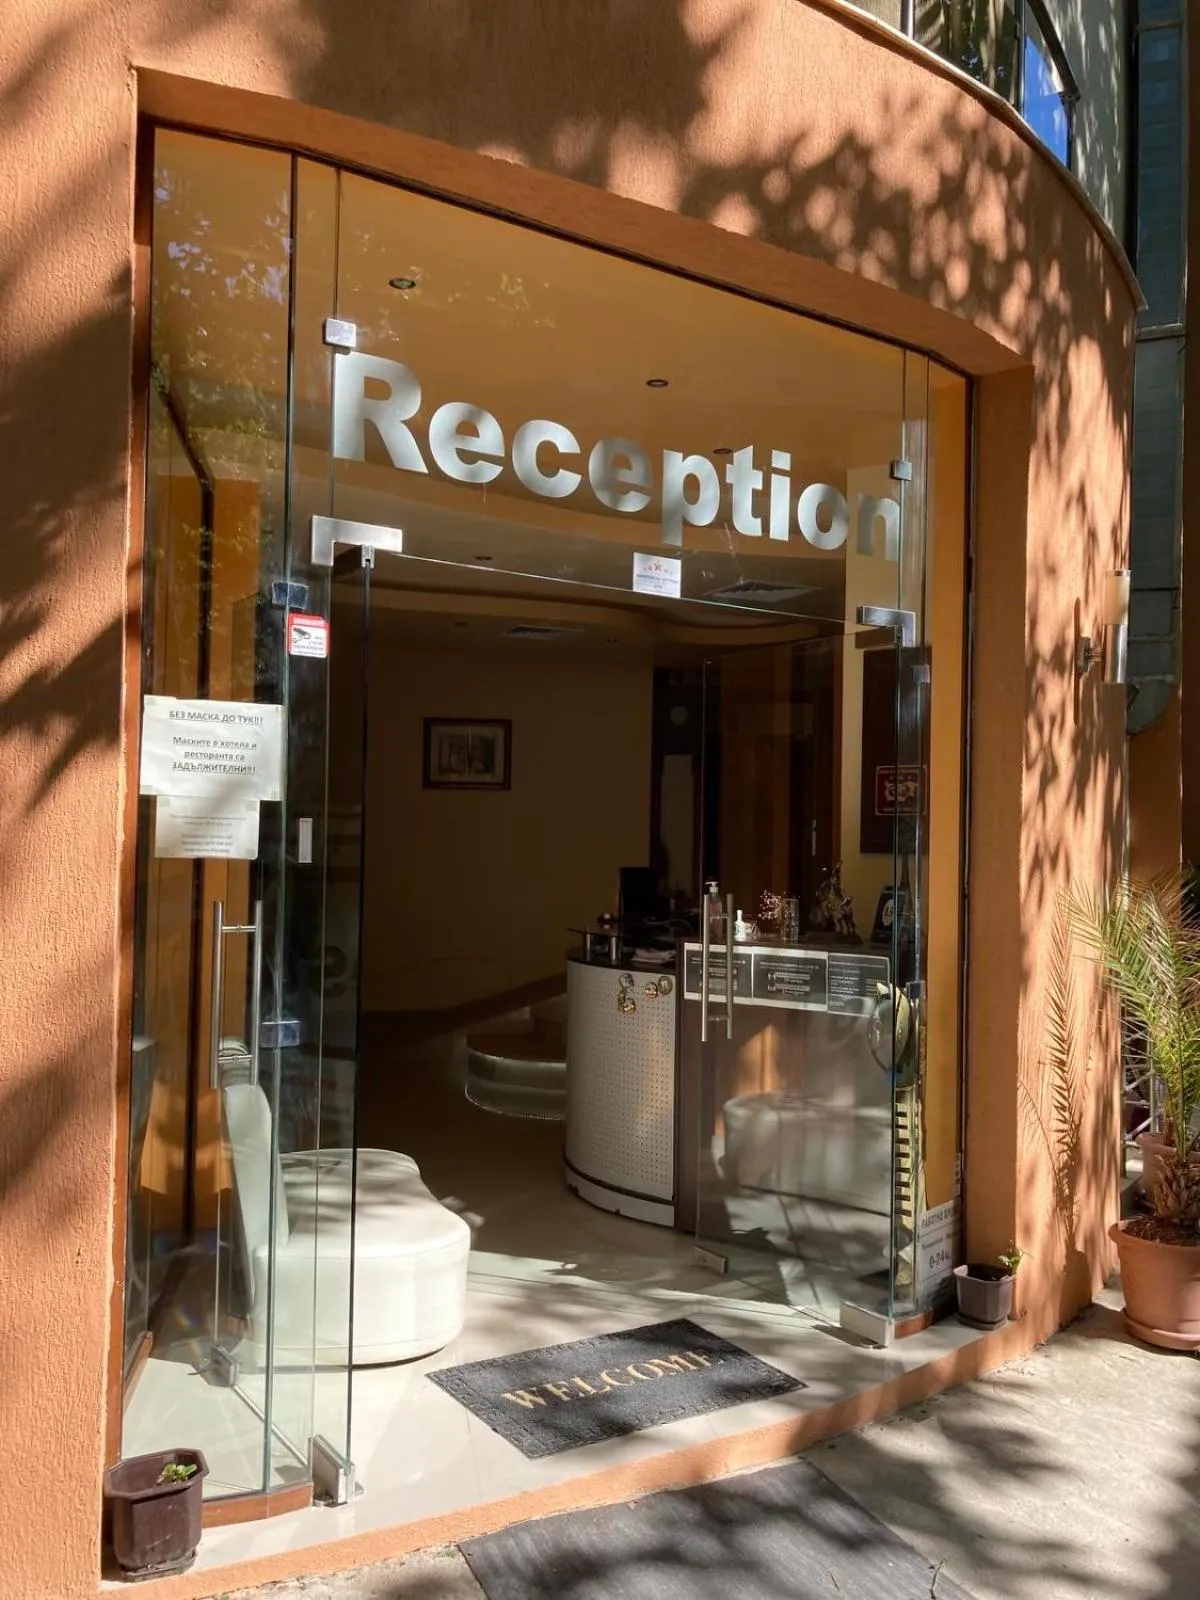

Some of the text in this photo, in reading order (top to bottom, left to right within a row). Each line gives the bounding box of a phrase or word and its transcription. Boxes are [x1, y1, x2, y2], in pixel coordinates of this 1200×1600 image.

[333, 350, 901, 561] Reception
[169, 710, 186, 720] БЕЗ
[187, 711, 220, 722] МАСКА
[221, 714, 236, 724] ДО
[173, 736, 211, 747] Маските
[183, 751, 245, 761] ресторанта са
[501, 1351, 726, 1409] WELCOME
